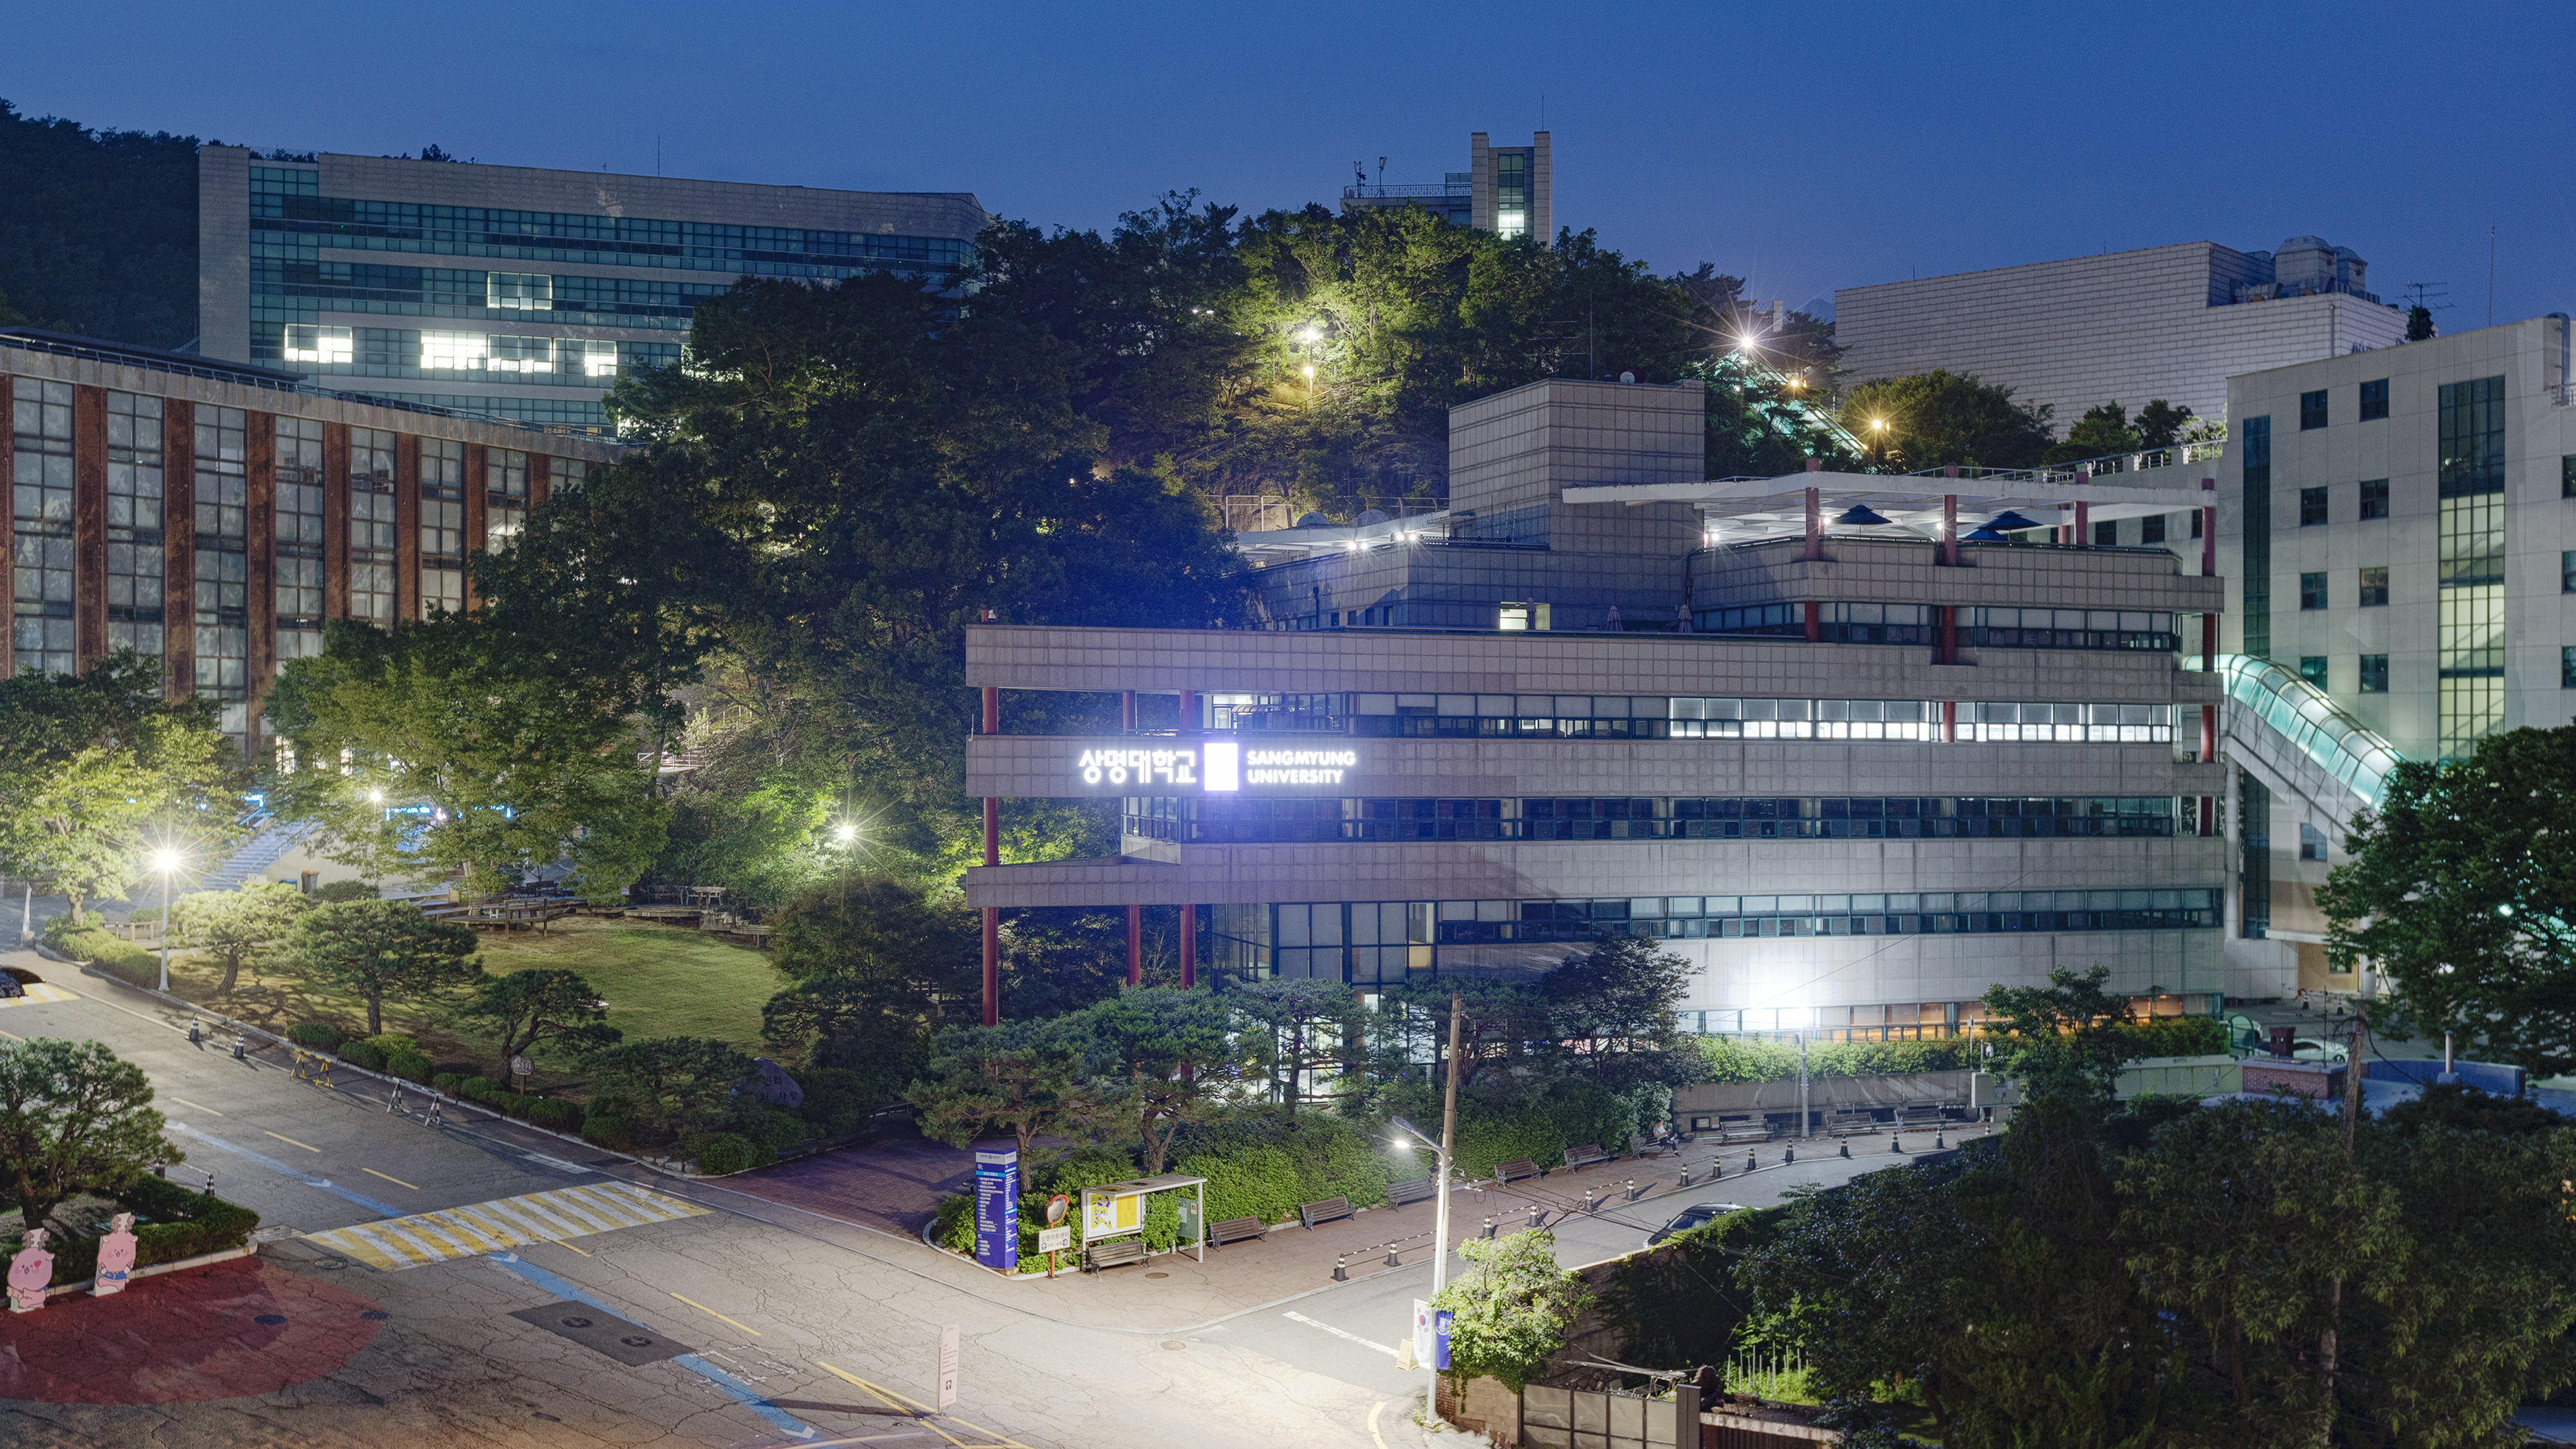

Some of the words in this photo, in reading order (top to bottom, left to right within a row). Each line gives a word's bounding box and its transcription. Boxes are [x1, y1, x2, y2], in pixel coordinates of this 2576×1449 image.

[1247, 750, 1356, 766] SANGMYUNG
[1079, 749, 1196, 784] 상명대학교
[1248, 769, 1343, 784] UNIVERSITY
[1041, 1231, 1069, 1242] 상명아트센터
